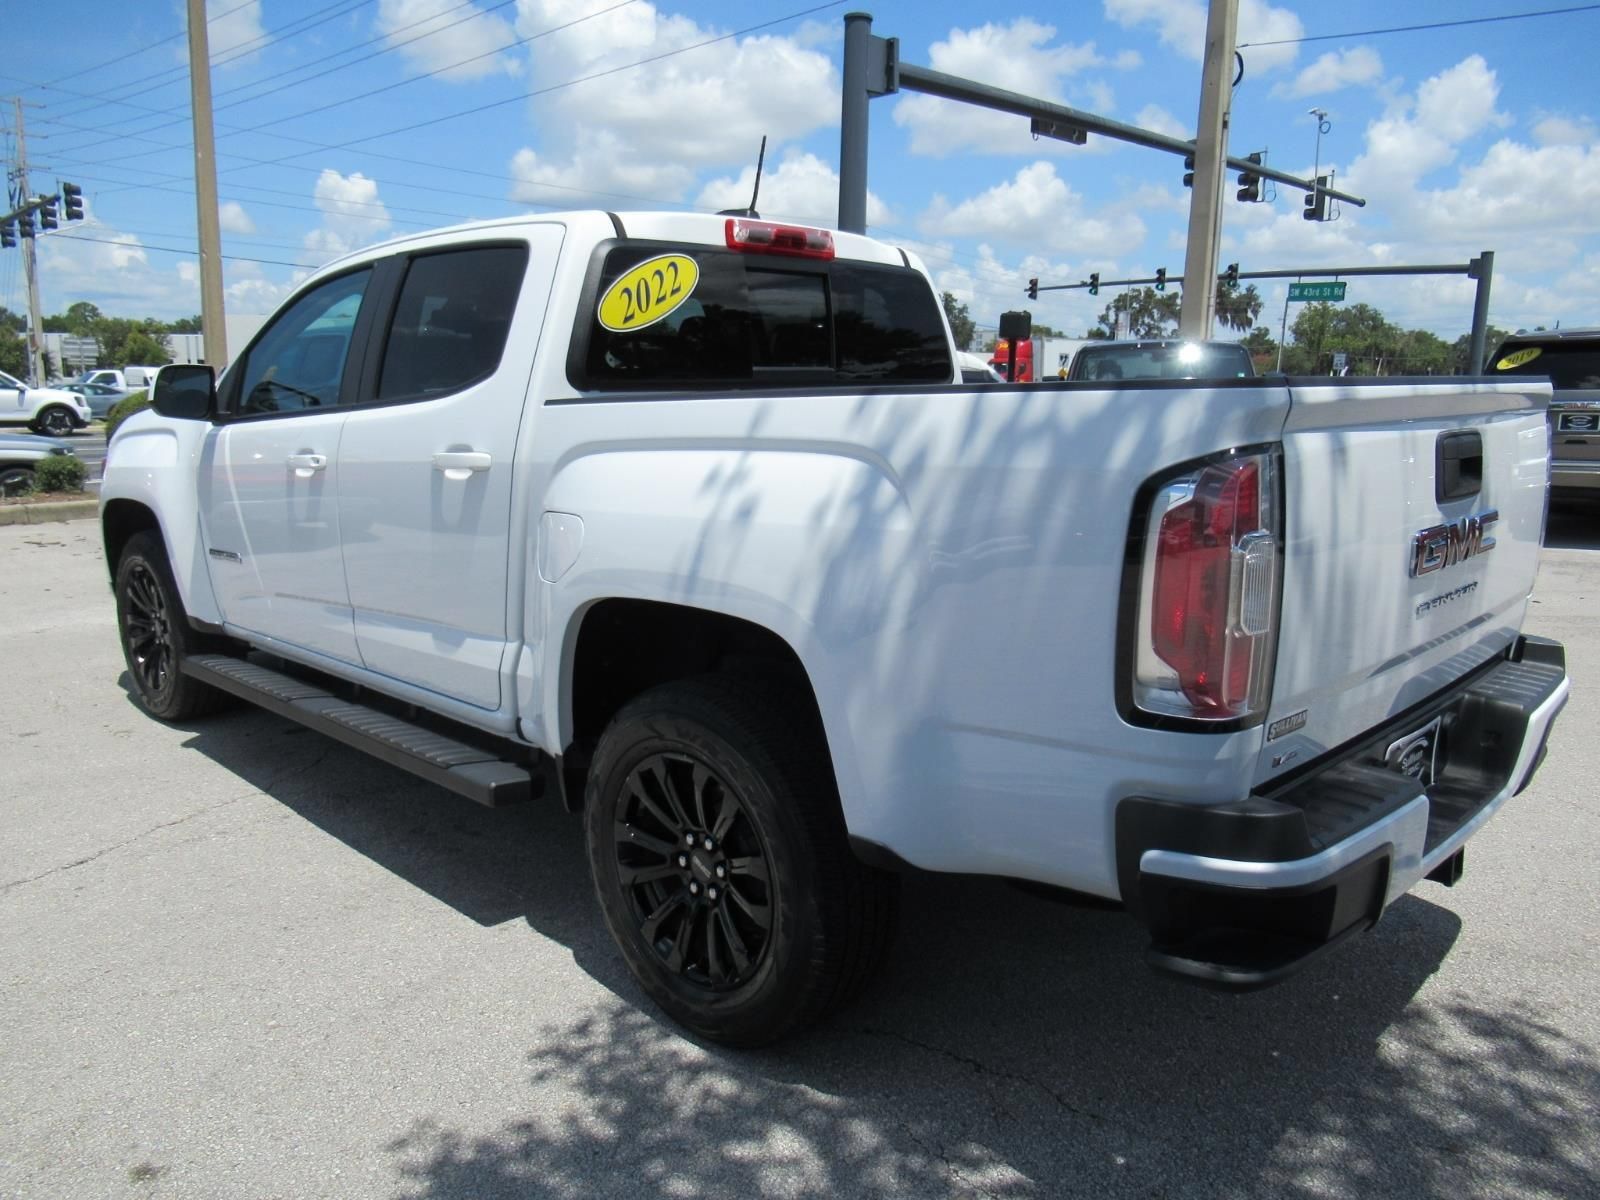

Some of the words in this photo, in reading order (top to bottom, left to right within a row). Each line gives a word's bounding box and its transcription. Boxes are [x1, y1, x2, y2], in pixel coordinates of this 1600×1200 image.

[619, 261, 682, 325] 2022
[1290, 288, 1300, 297] SW
[1303, 287, 1320, 297] 43rd
[1322, 287, 1331, 297] St
[1334, 287, 1343, 297] Rd
[1408, 508, 1499, 578] GMC
